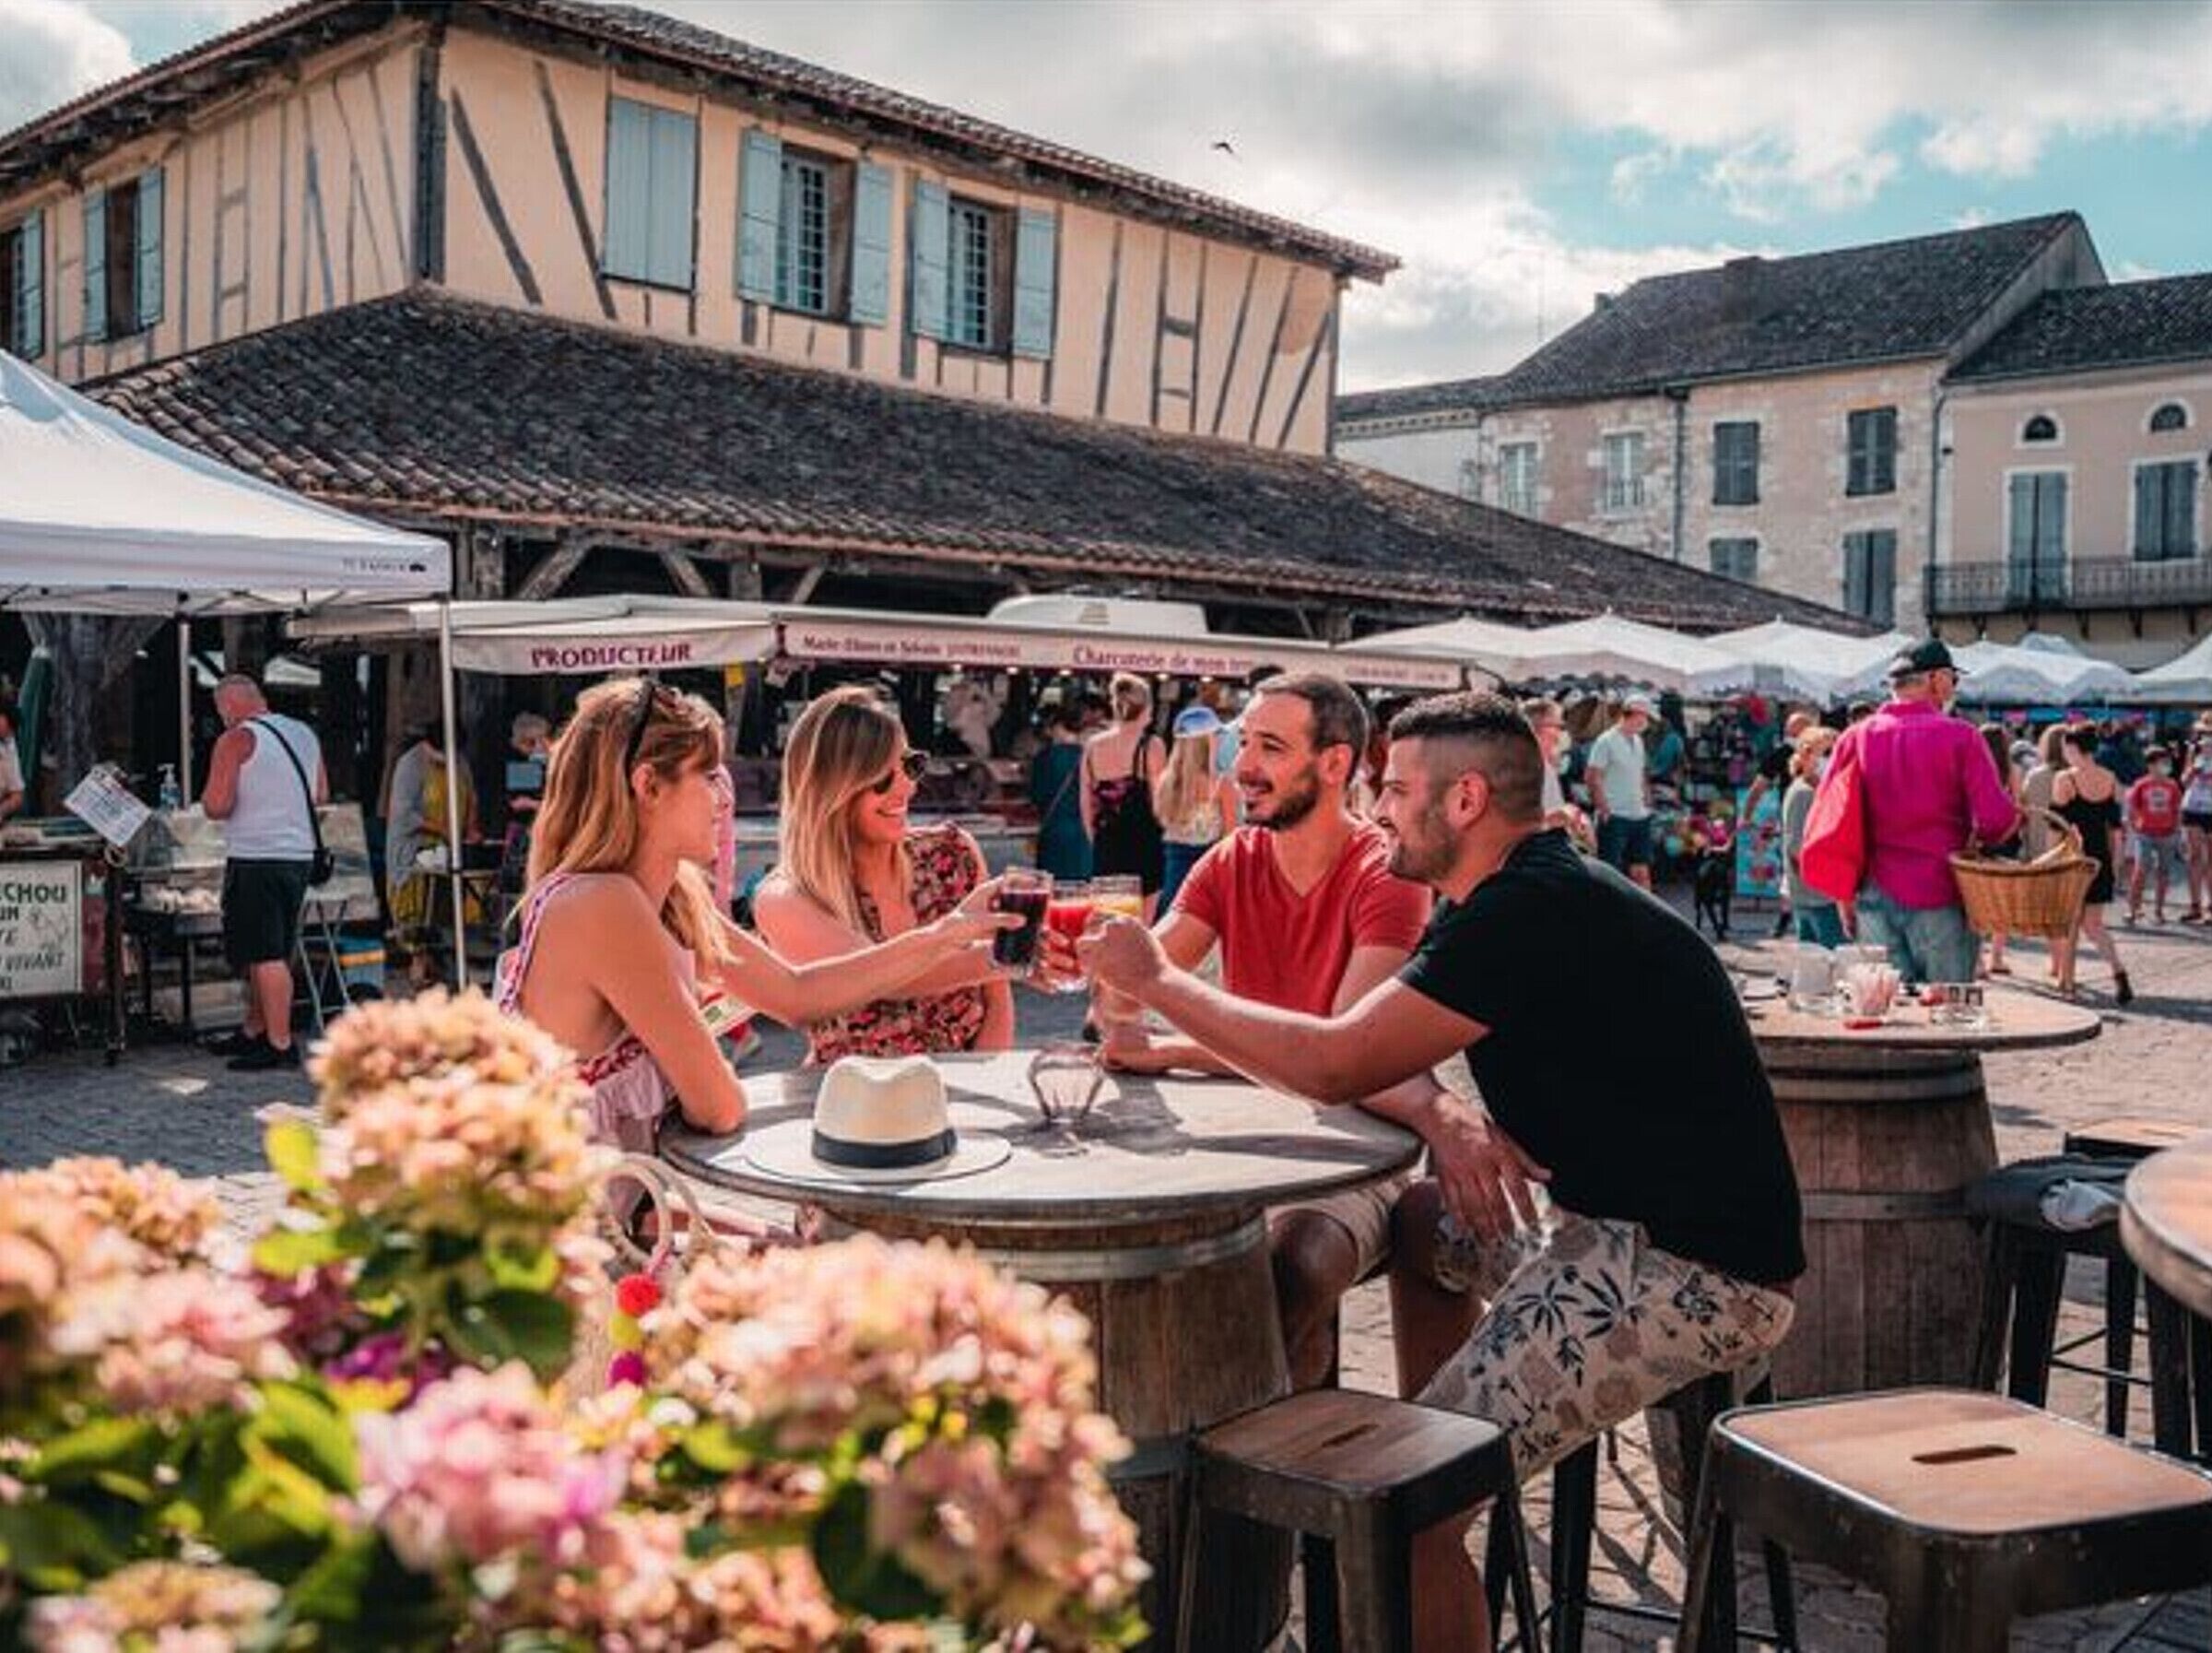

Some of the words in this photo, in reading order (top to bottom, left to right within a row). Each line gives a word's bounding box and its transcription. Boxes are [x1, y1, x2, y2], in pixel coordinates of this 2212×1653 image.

[531, 643, 691, 668] PRODUCTEUR
[1074, 645, 1164, 666] Charcuterie
[0, 882, 67, 904] CHOU
